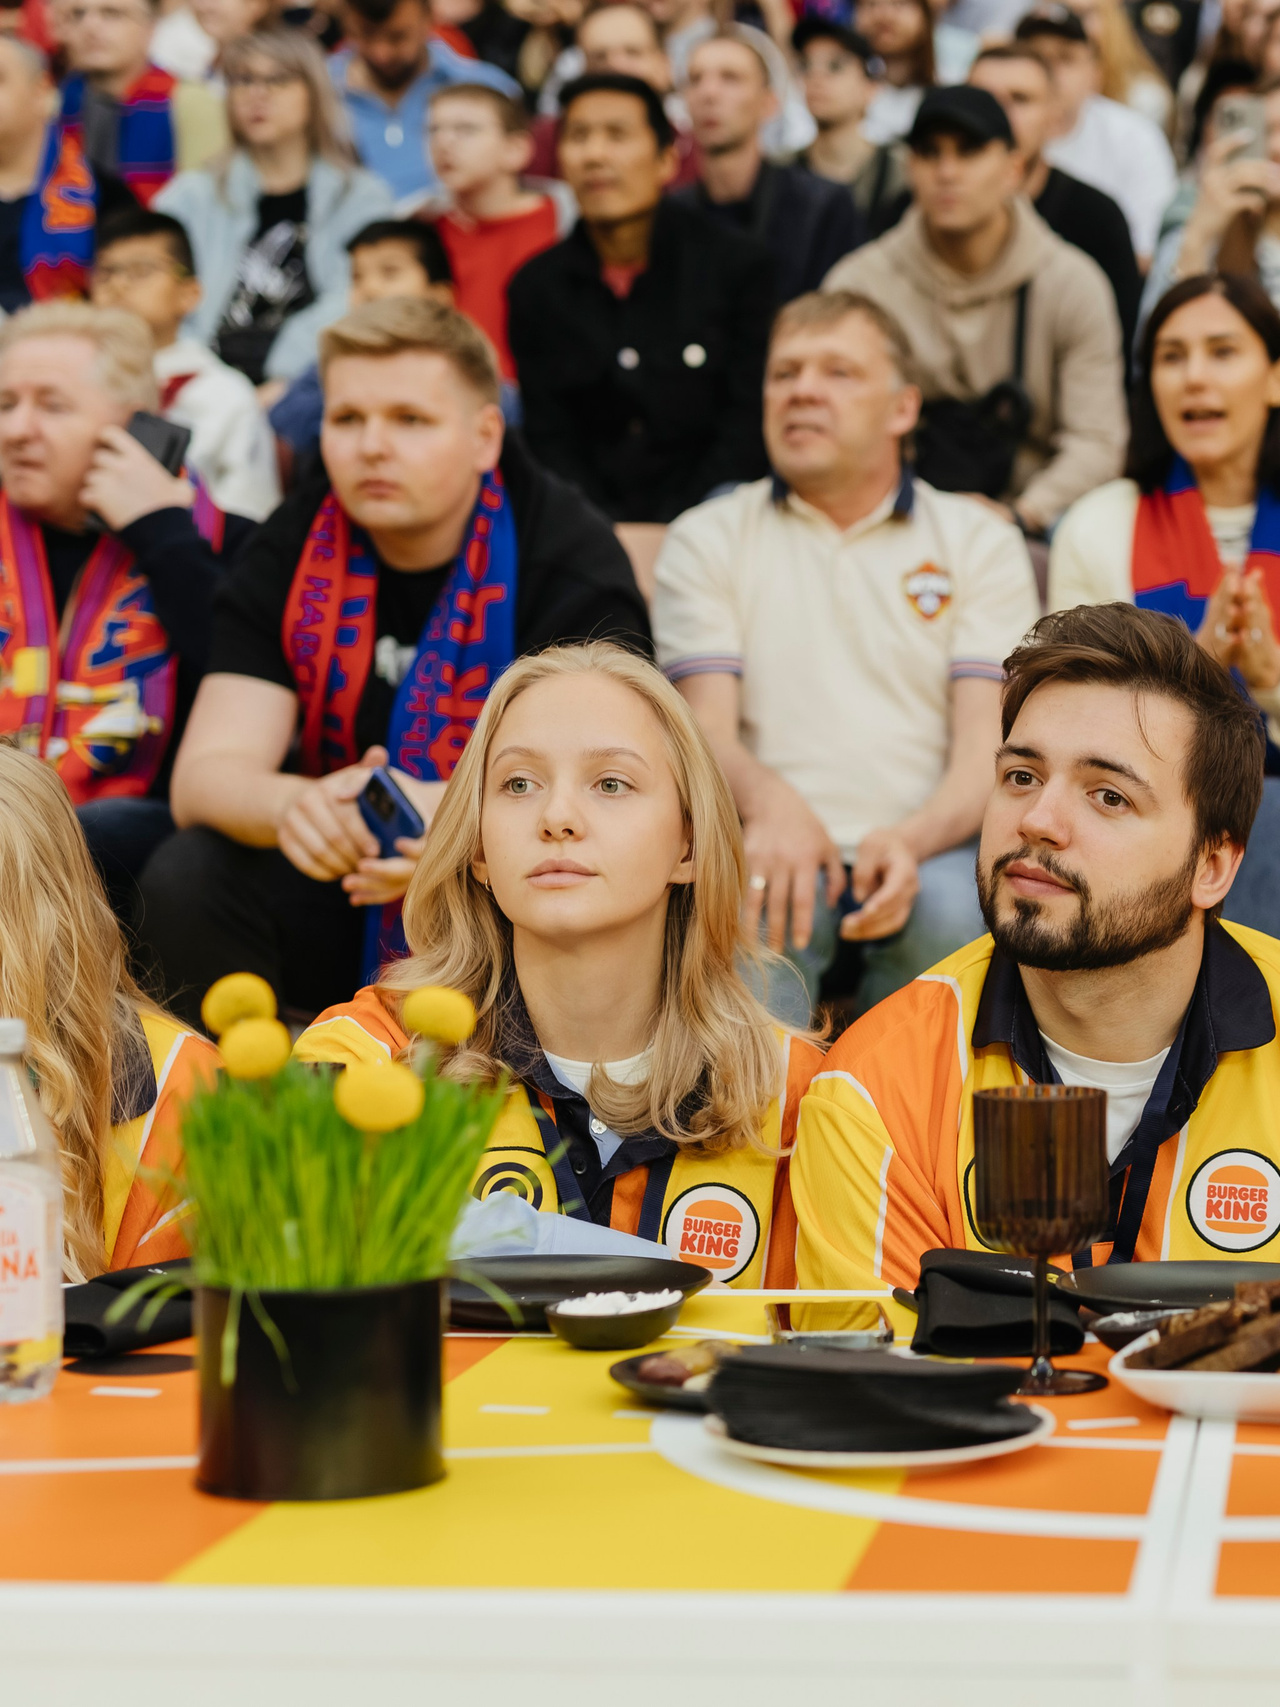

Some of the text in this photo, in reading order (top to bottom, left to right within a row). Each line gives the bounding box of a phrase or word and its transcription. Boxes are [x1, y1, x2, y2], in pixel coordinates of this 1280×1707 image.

[1207, 1184, 1269, 1203] BURGER
[1205, 1199, 1268, 1222] KING
[682, 1217, 742, 1239] BURGER
[680, 1232, 739, 1259] KING
